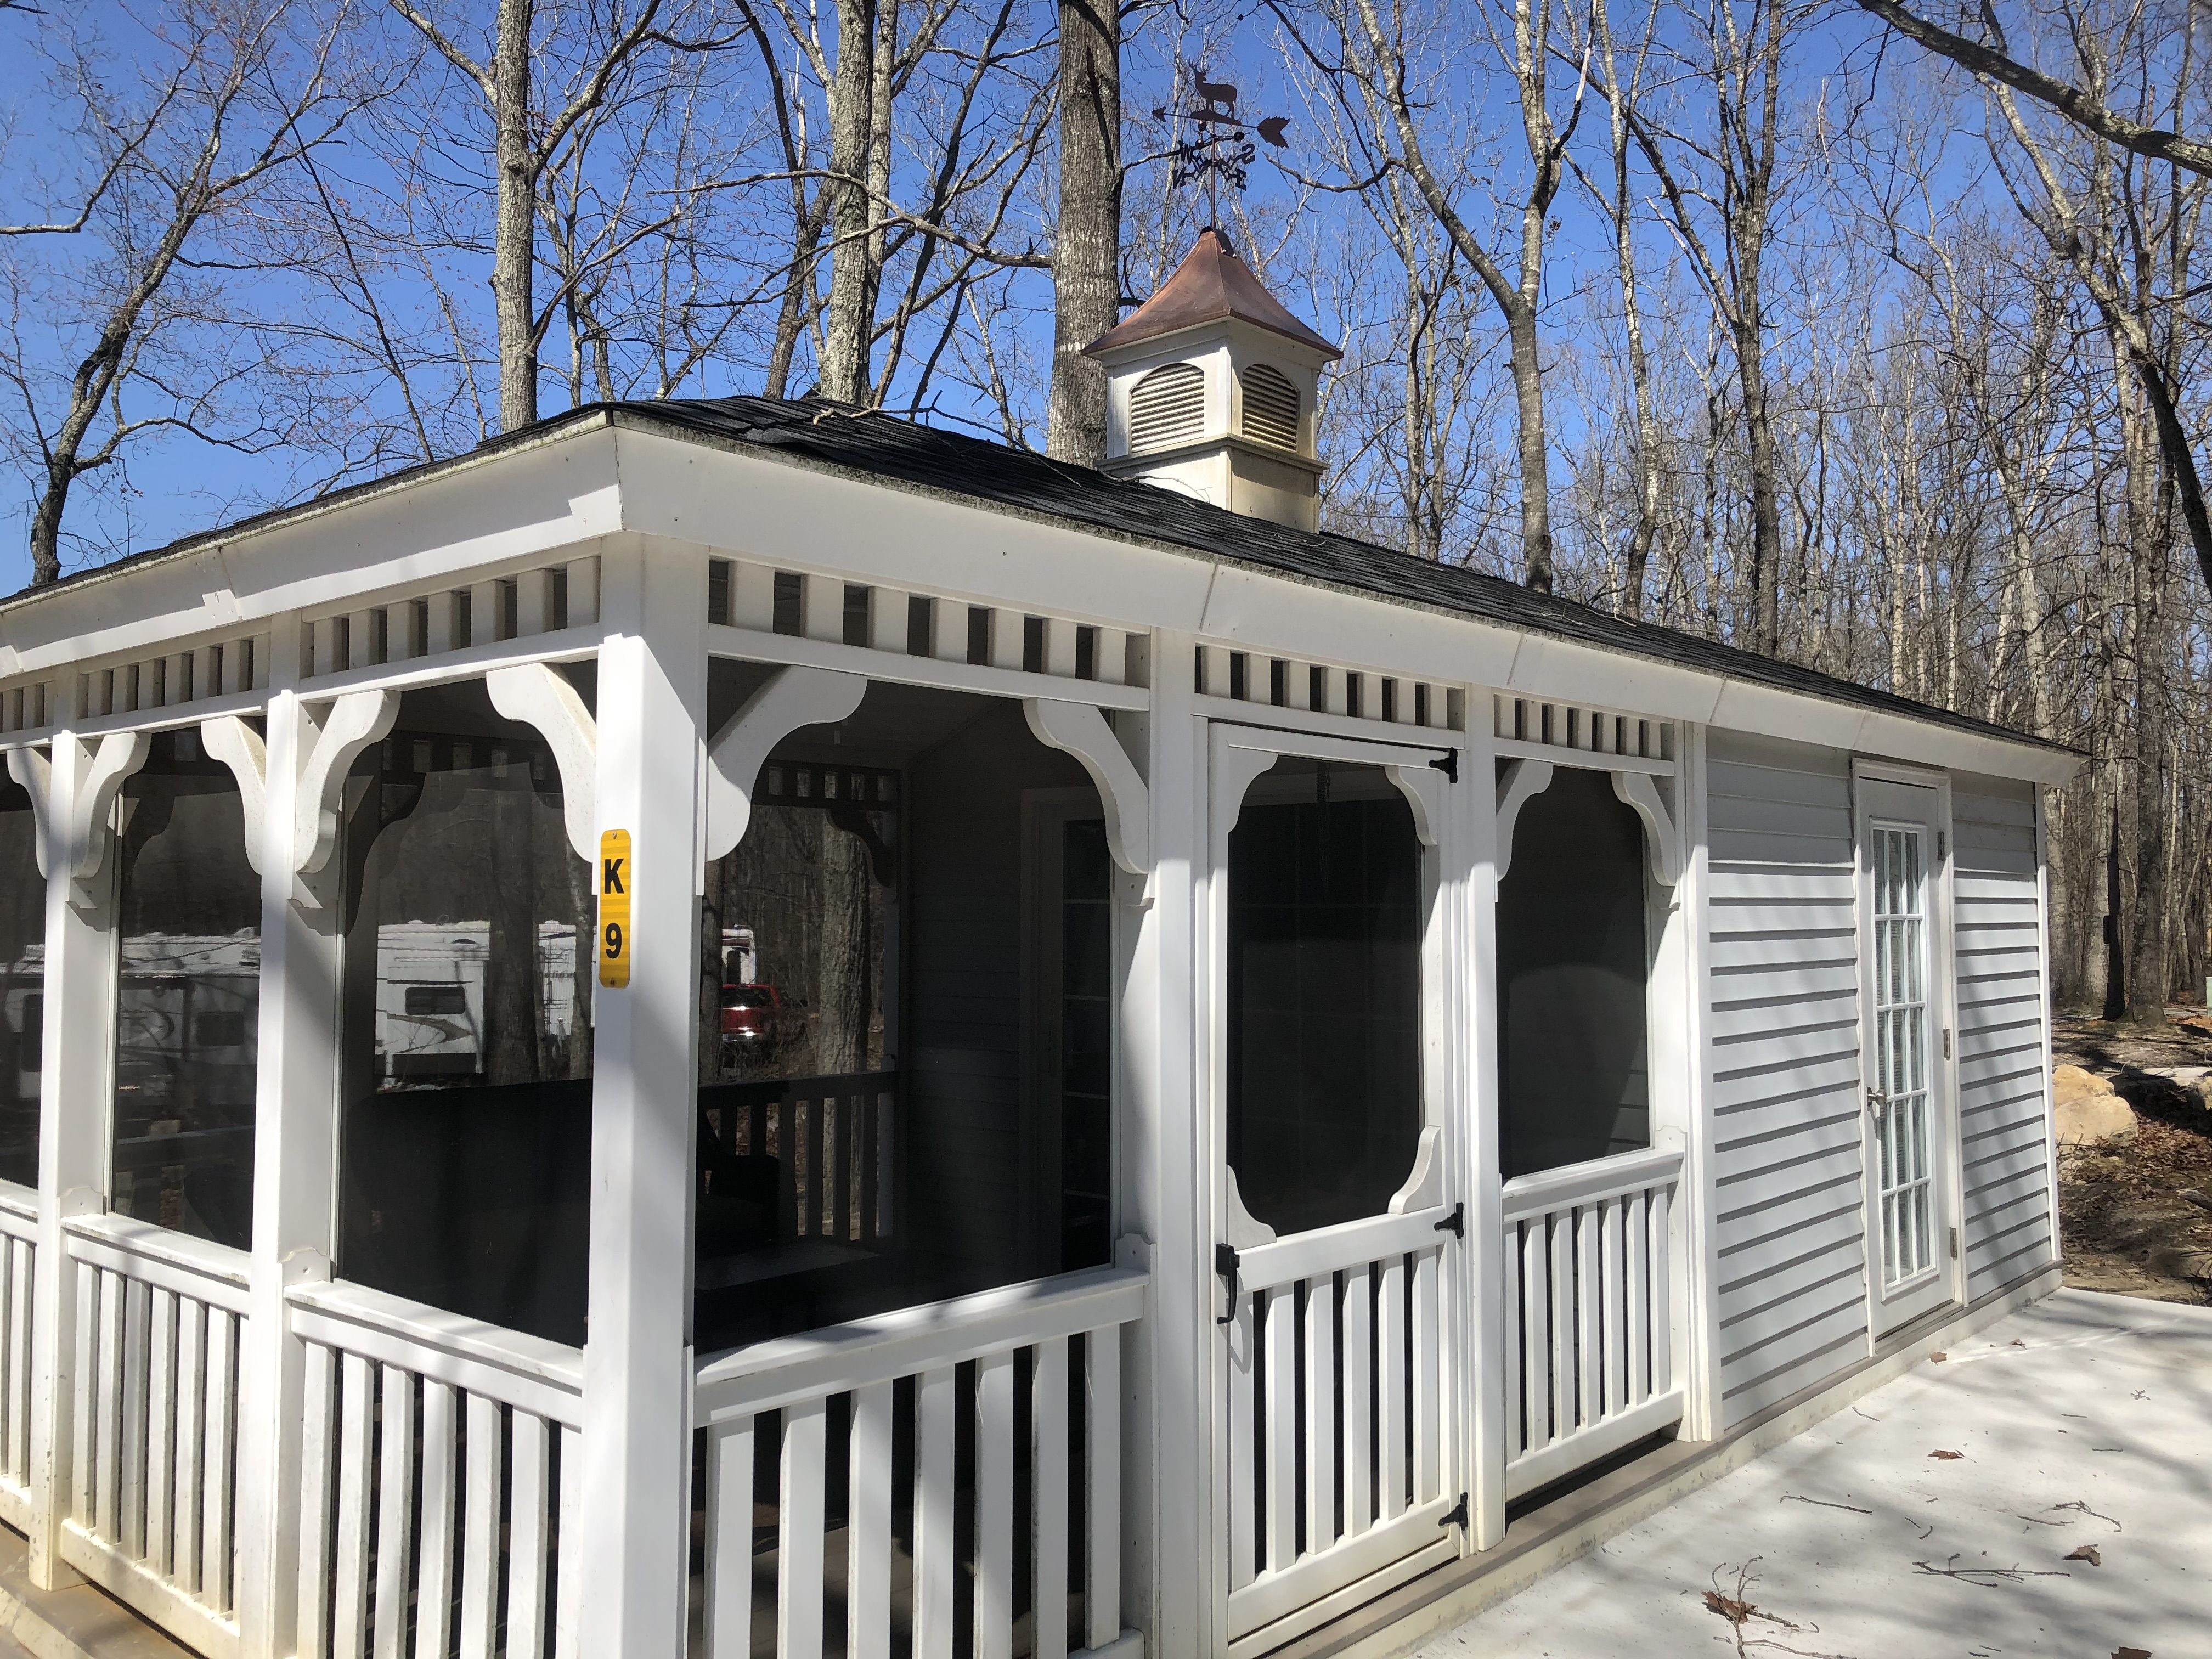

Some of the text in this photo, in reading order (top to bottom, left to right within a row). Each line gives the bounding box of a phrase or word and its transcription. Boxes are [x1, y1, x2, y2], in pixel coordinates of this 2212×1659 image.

[1235, 167, 1246, 191] E
[604, 859, 624, 894] K
[605, 922, 622, 959] 9
